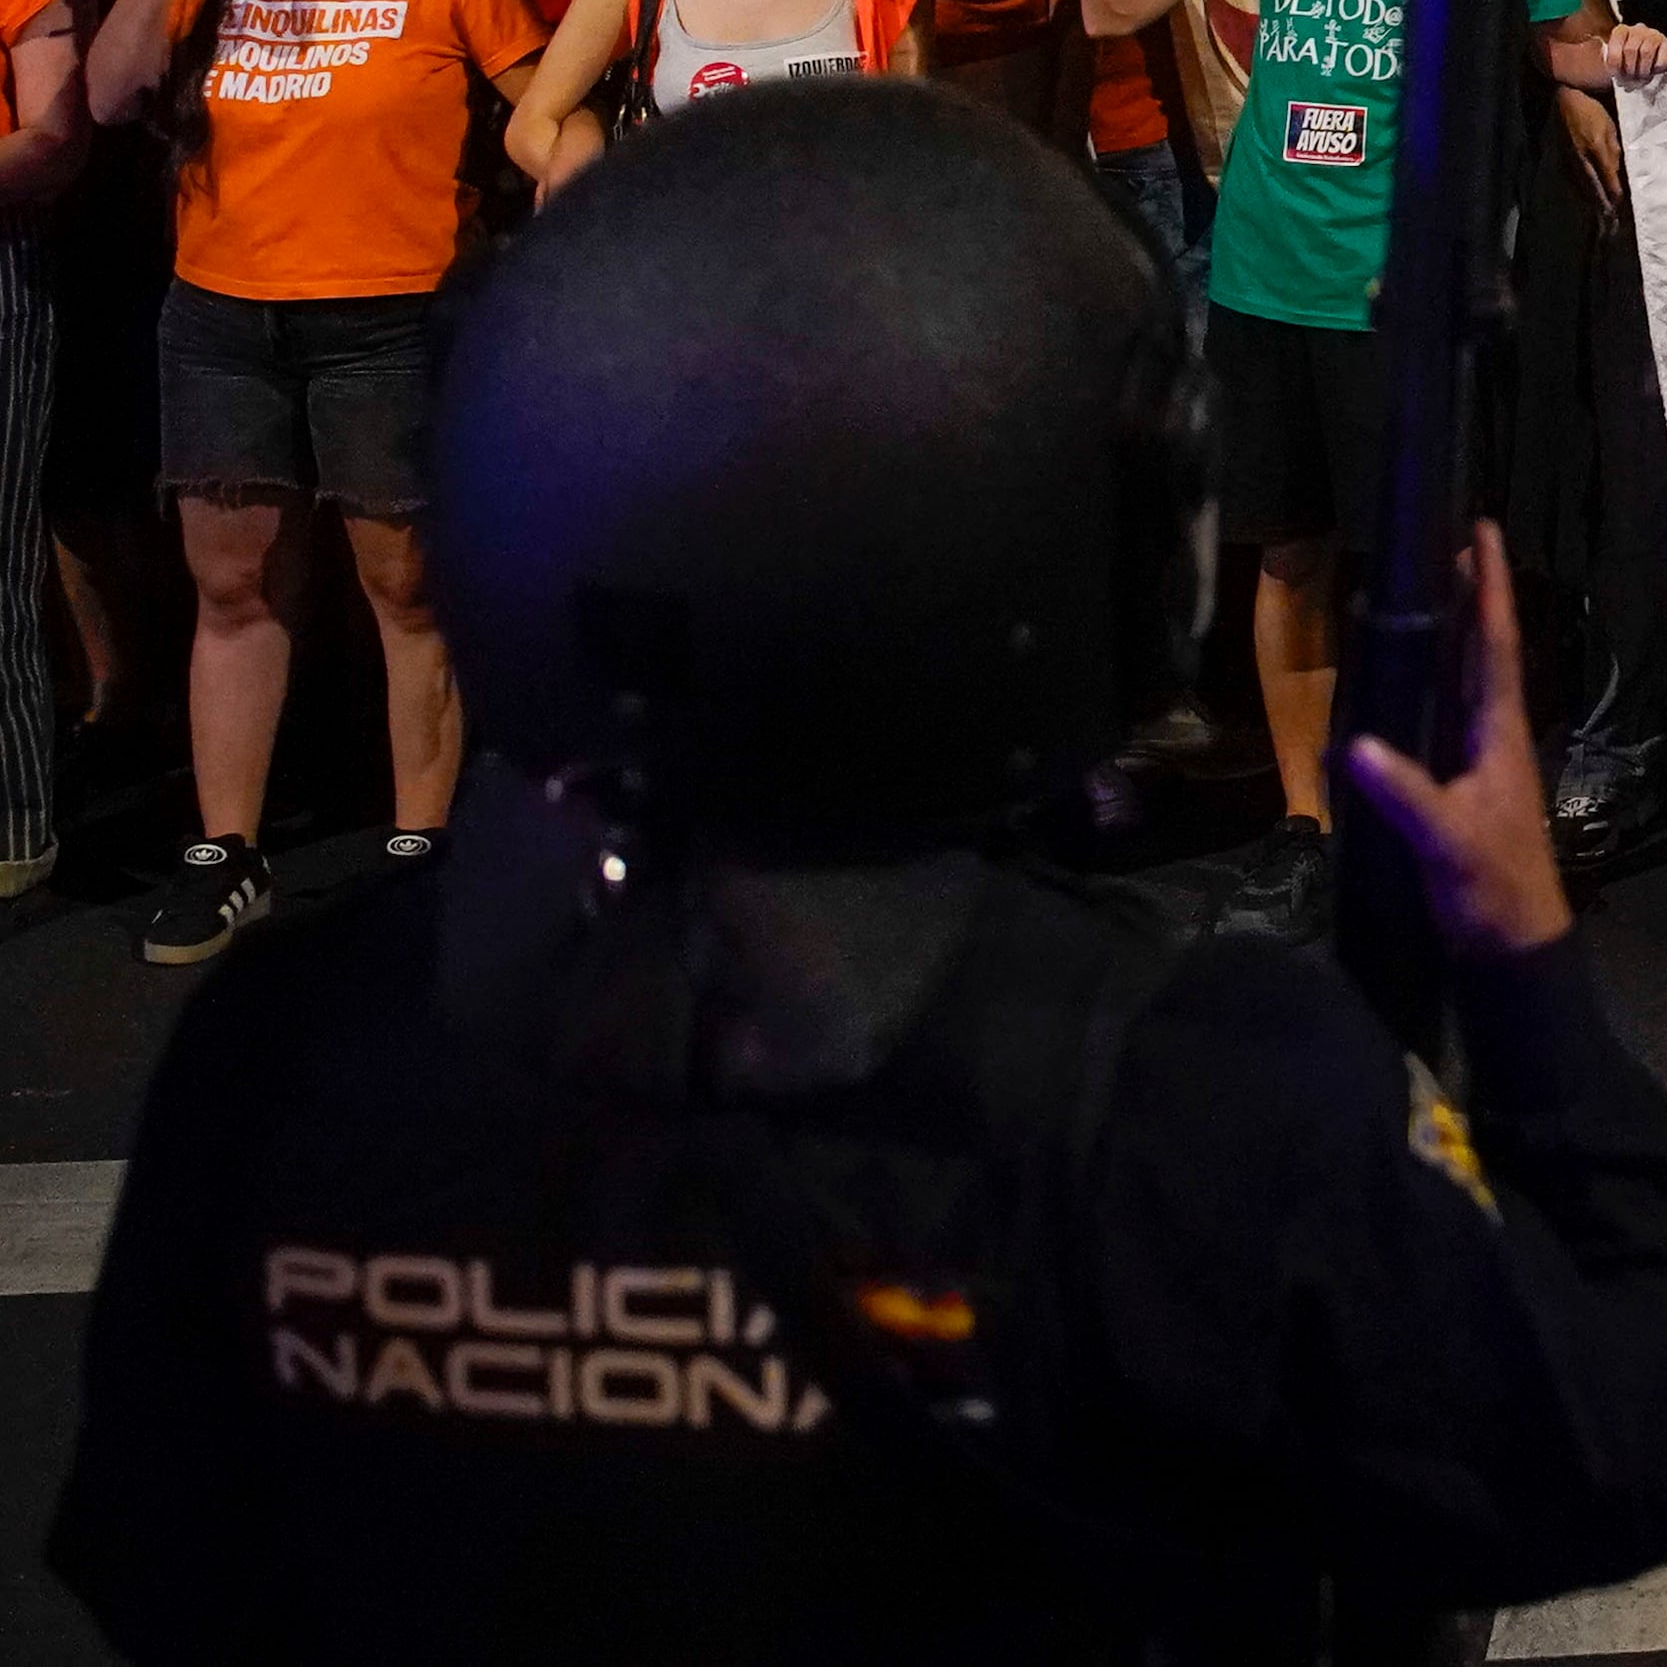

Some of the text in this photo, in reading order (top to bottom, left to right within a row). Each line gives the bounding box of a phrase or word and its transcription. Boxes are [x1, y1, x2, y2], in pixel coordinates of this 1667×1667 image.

[241, 4, 399, 36] INQUILINAS
[1259, 29, 1318, 65] PARA
[218, 71, 332, 104] MADRID
[1302, 107, 1356, 132] FUERA
[1296, 129, 1357, 155] AYUSO
[264, 1245, 776, 1346] POLICI
